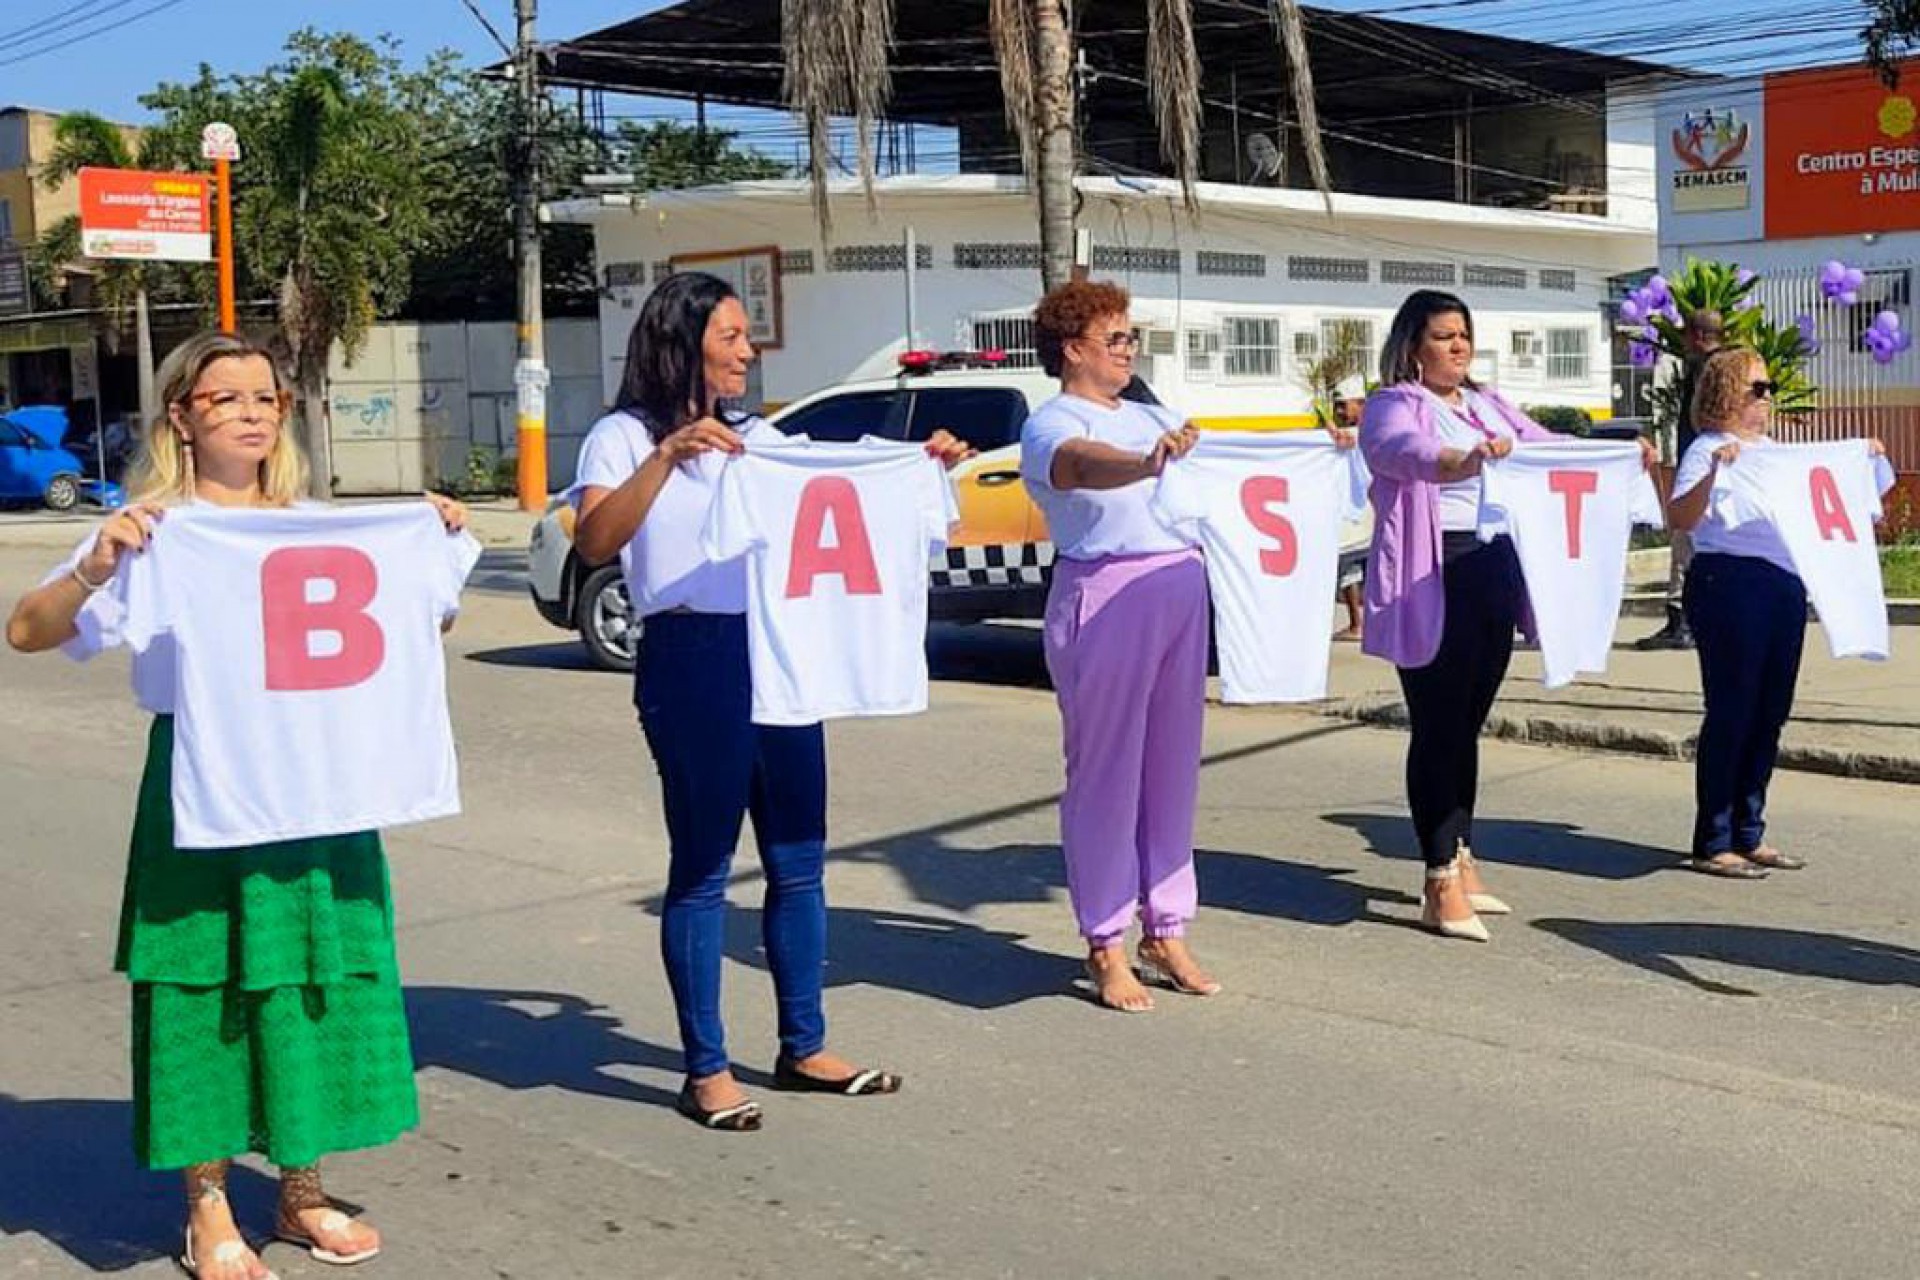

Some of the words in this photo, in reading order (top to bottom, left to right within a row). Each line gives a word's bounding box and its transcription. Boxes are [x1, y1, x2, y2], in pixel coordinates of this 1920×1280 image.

[1673, 171, 1748, 188] SEMASCM
[1797, 151, 1866, 173] Centro
[1877, 168, 1920, 193] Mul
[786, 476, 881, 598] A
[1240, 475, 1298, 577] S
[1549, 470, 1598, 558] T
[1809, 466, 1858, 543] A
[261, 546, 385, 691] B
